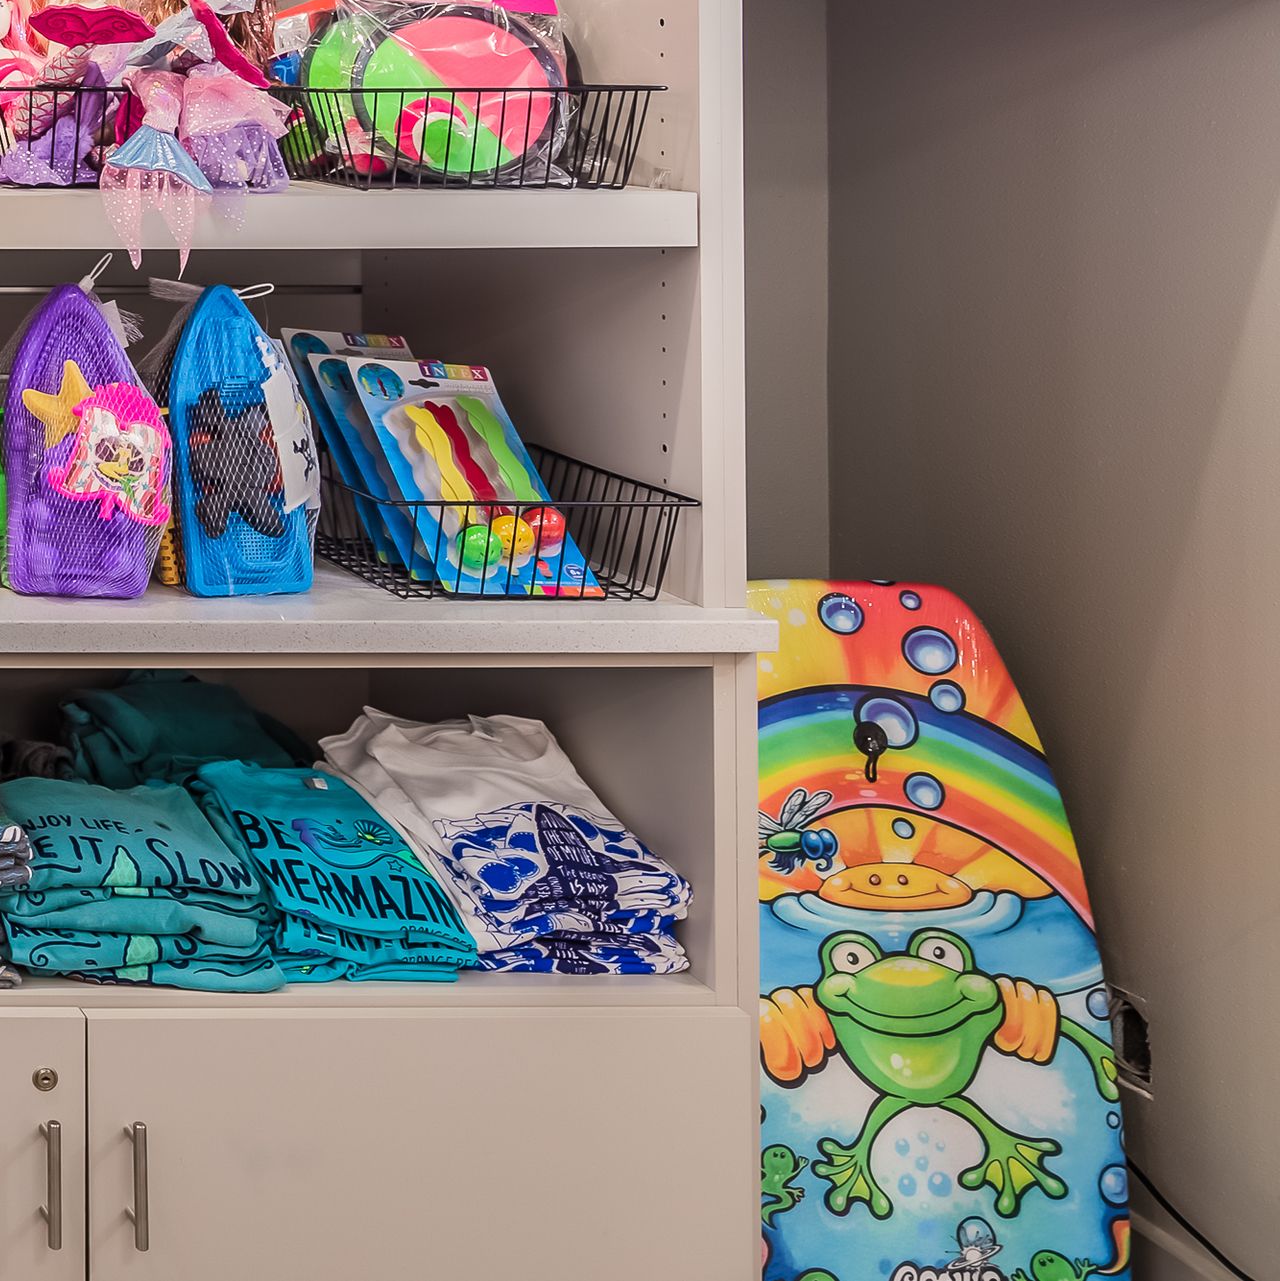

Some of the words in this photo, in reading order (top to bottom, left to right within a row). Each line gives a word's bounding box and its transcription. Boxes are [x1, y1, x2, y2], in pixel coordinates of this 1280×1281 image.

[423, 366, 487, 381] INTEX
[22, 814, 72, 832] NJOY
[80, 817, 130, 834] LIFE
[233, 809, 303, 853] BE
[69, 835, 103, 864] IT
[145, 838, 253, 890] SLOW
[255, 859, 465, 935] MERMAZIN
